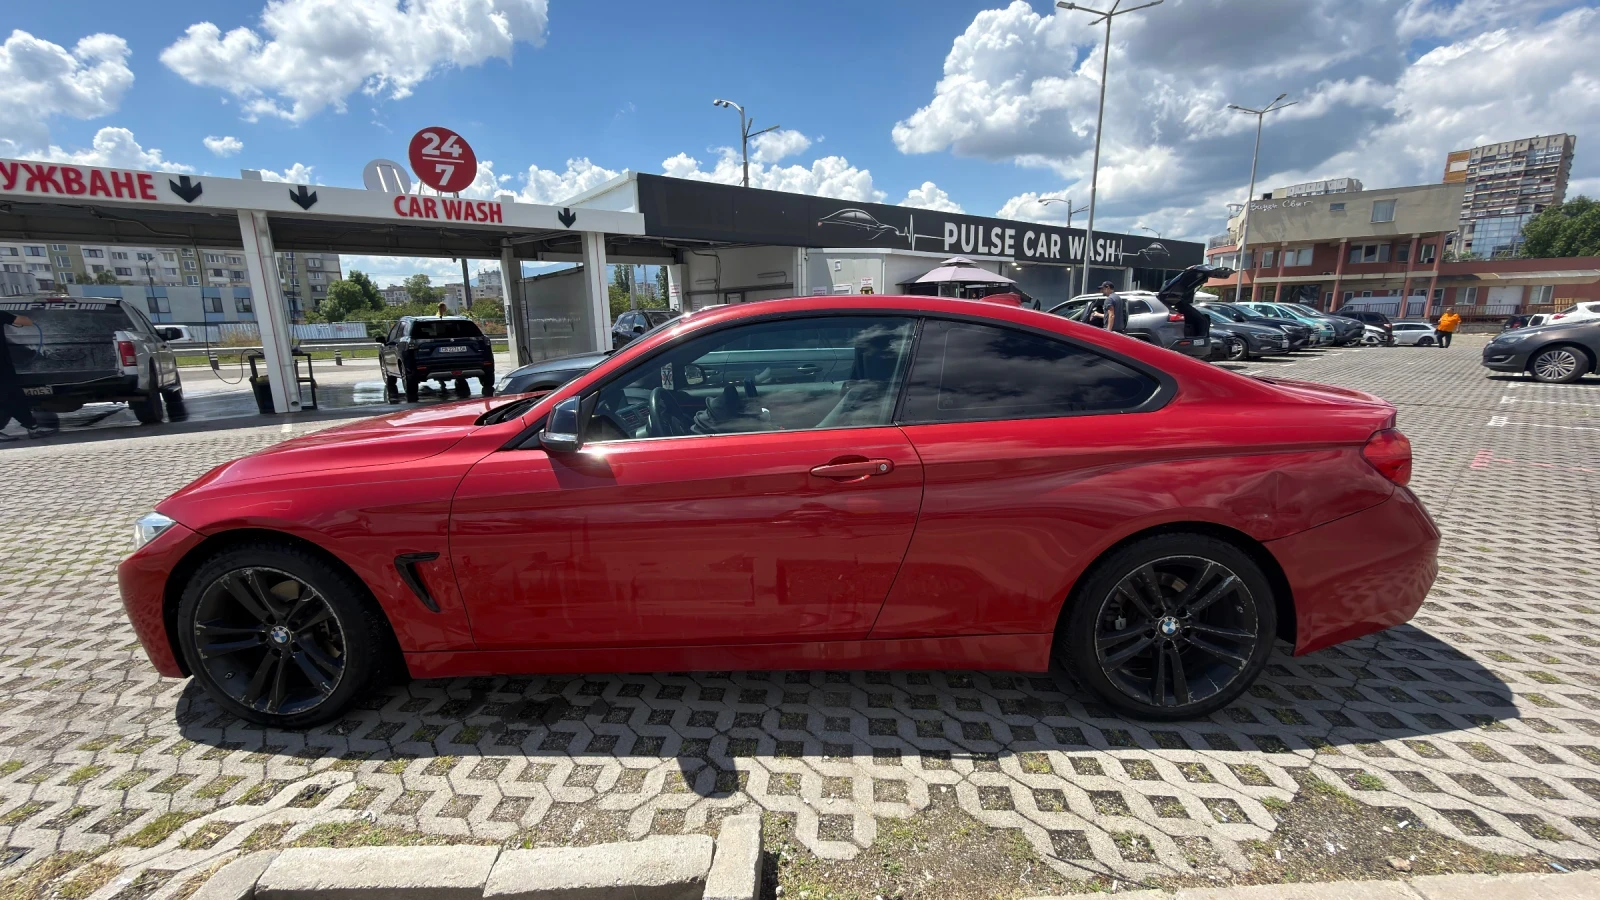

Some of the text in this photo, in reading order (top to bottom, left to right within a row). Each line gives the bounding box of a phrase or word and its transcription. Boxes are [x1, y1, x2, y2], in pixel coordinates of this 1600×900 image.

[421, 132, 463, 158] 24
[0, 161, 157, 200] УЖВАНЕ
[435, 163, 455, 186] 7
[393, 195, 503, 223] CAR WASH
[944, 221, 1016, 256] PULSE
[1023, 230, 1061, 260] CAR
[27, 302, 80, 311] F-150
